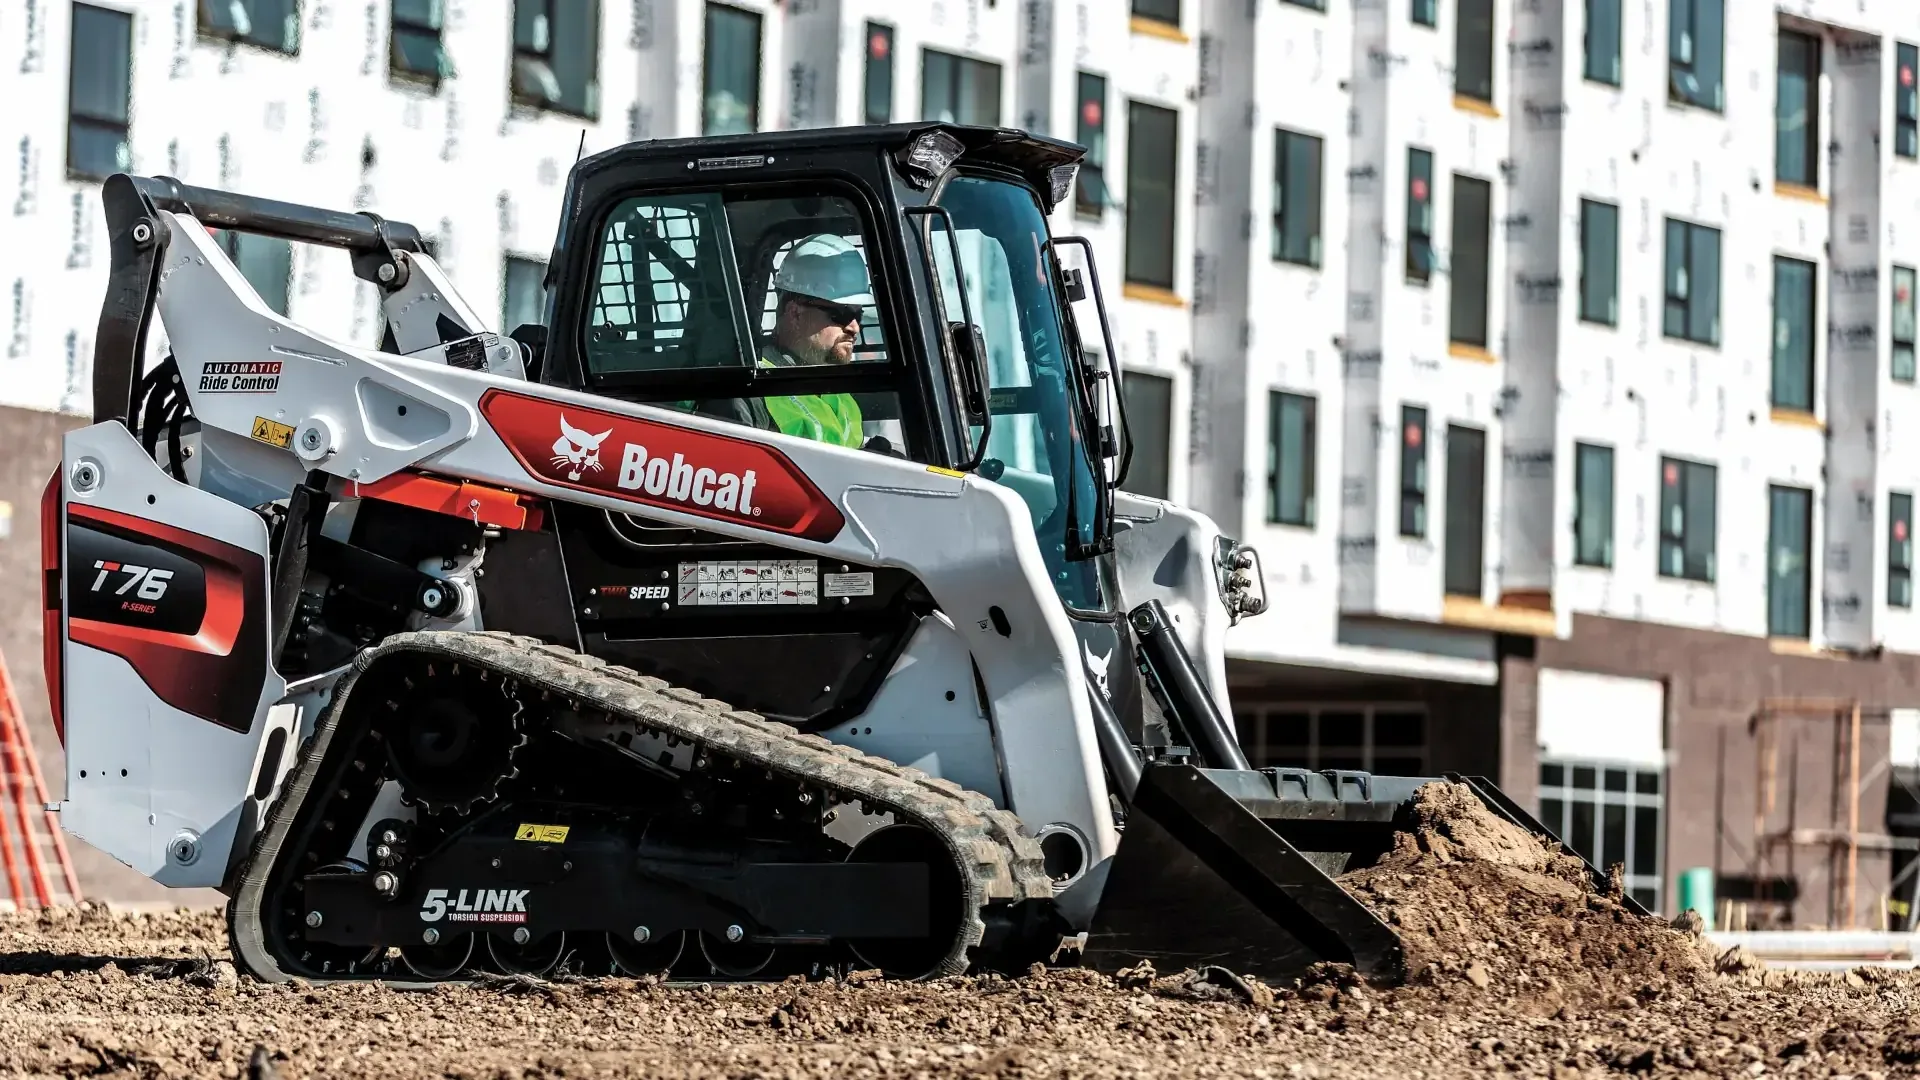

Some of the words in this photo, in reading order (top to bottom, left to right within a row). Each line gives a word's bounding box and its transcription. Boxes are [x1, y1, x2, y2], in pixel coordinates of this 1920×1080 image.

[206, 364, 279, 374] AUTOMATIC
[199, 375, 229, 390] Ride
[231, 375, 280, 390] Control
[91, 559, 175, 601] T76
[629, 586, 670, 600] SPEED
[121, 601, 157, 614] R-SERIES
[419, 888, 531, 922] 5-LINK
[448, 913, 479, 922] TORSION
[480, 913, 525, 922] SUSPENSION
